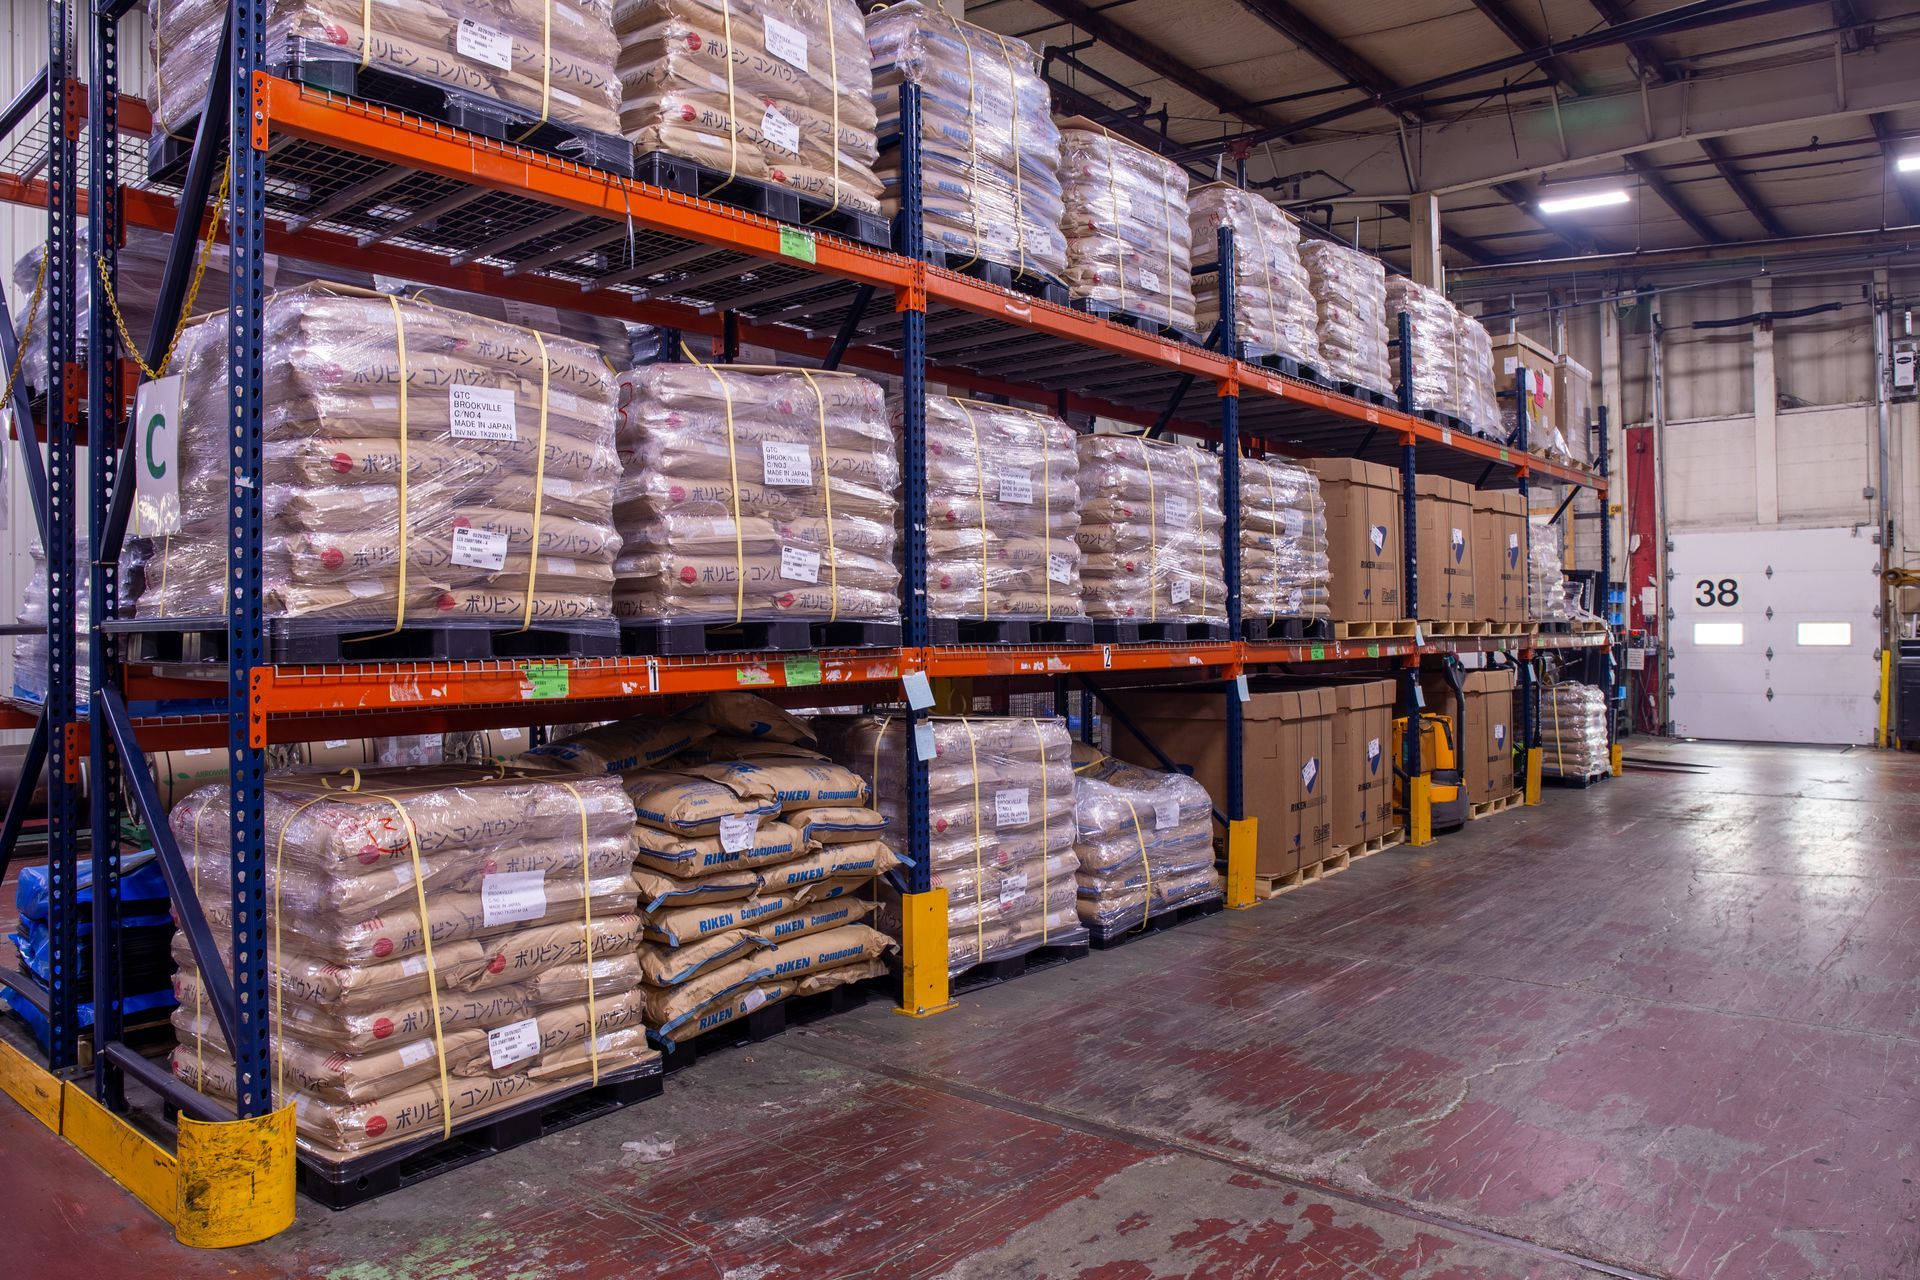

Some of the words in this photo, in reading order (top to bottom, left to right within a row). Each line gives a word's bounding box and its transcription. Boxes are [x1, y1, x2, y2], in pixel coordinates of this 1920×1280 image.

[453, 390, 471, 400] GTC
[453, 400, 502, 412] BROOKVILLE
[454, 419, 476, 428] MADE
[478, 421, 486, 429] IN
[487, 422, 513, 431] JAPAN
[145, 413, 167, 480] C
[1695, 579, 1739, 607] 38
[465, 595, 521, 615] ポリビン
[1105, 647, 1111, 667] 2
[777, 790, 811, 801] RIKEN
[817, 789, 858, 800] Compound
[1290, 801, 1307, 813] RIKEN
[703, 851, 740, 866] RIKEN
[748, 842, 793, 858] Compound
[787, 867, 824, 884] RIKEN
[699, 913, 734, 933] RIKEN
[741, 899, 783, 919] Compound
[774, 919, 805, 937] RIKEN
[811, 908, 849, 926] Compound
[514, 944, 565, 969] ポリビン
[775, 956, 811, 975] RIKEN
[818, 944, 864, 964] Compound
[699, 1007, 733, 1030] RIKEN
